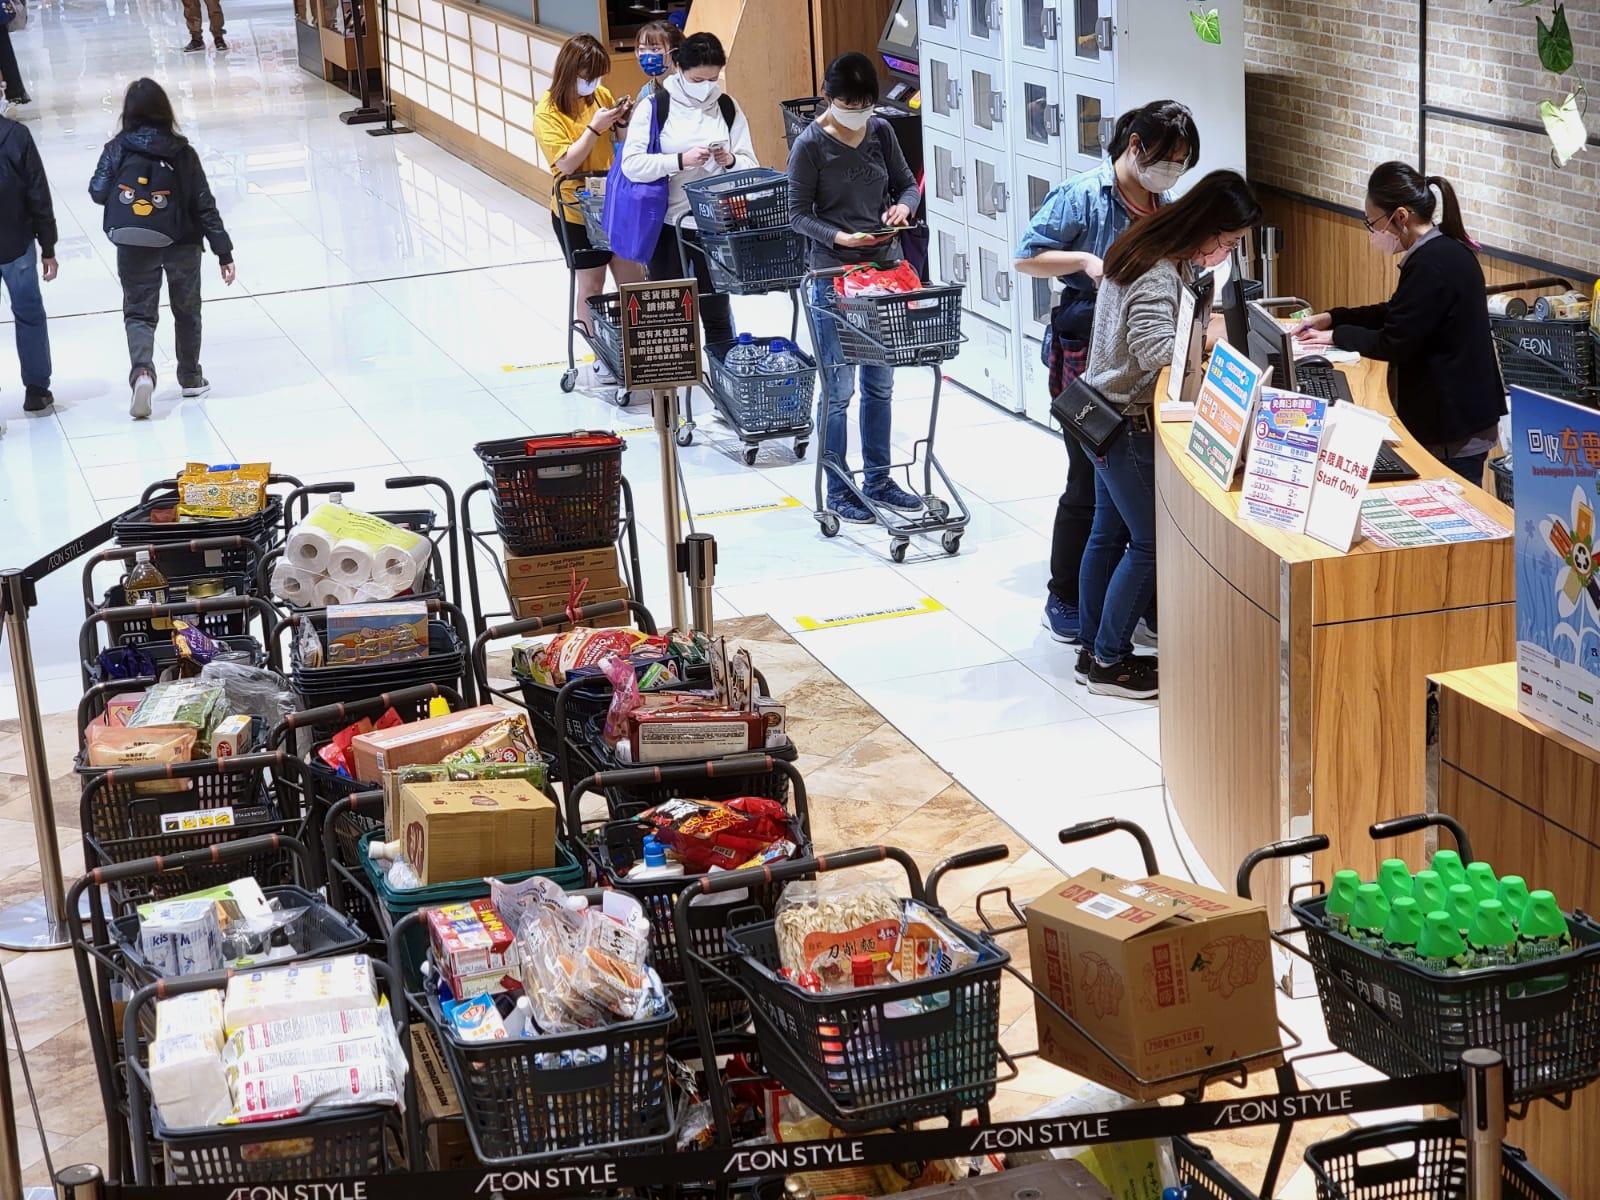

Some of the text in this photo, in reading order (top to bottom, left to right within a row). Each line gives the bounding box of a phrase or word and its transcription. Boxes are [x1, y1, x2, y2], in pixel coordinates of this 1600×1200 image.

[641, 289, 680, 300] 送貨服務
[646, 300, 676, 312] 請排隊
[1316, 470, 1359, 499] Staff Only
[65, 540, 85, 560] STYLE
[1282, 1090, 1353, 1117] STYLE
[1039, 1118, 1111, 1143] STYLE
[792, 1141, 865, 1167] STYLE
[545, 1163, 618, 1189] STYLE
[294, 1181, 368, 1200] STYLE
